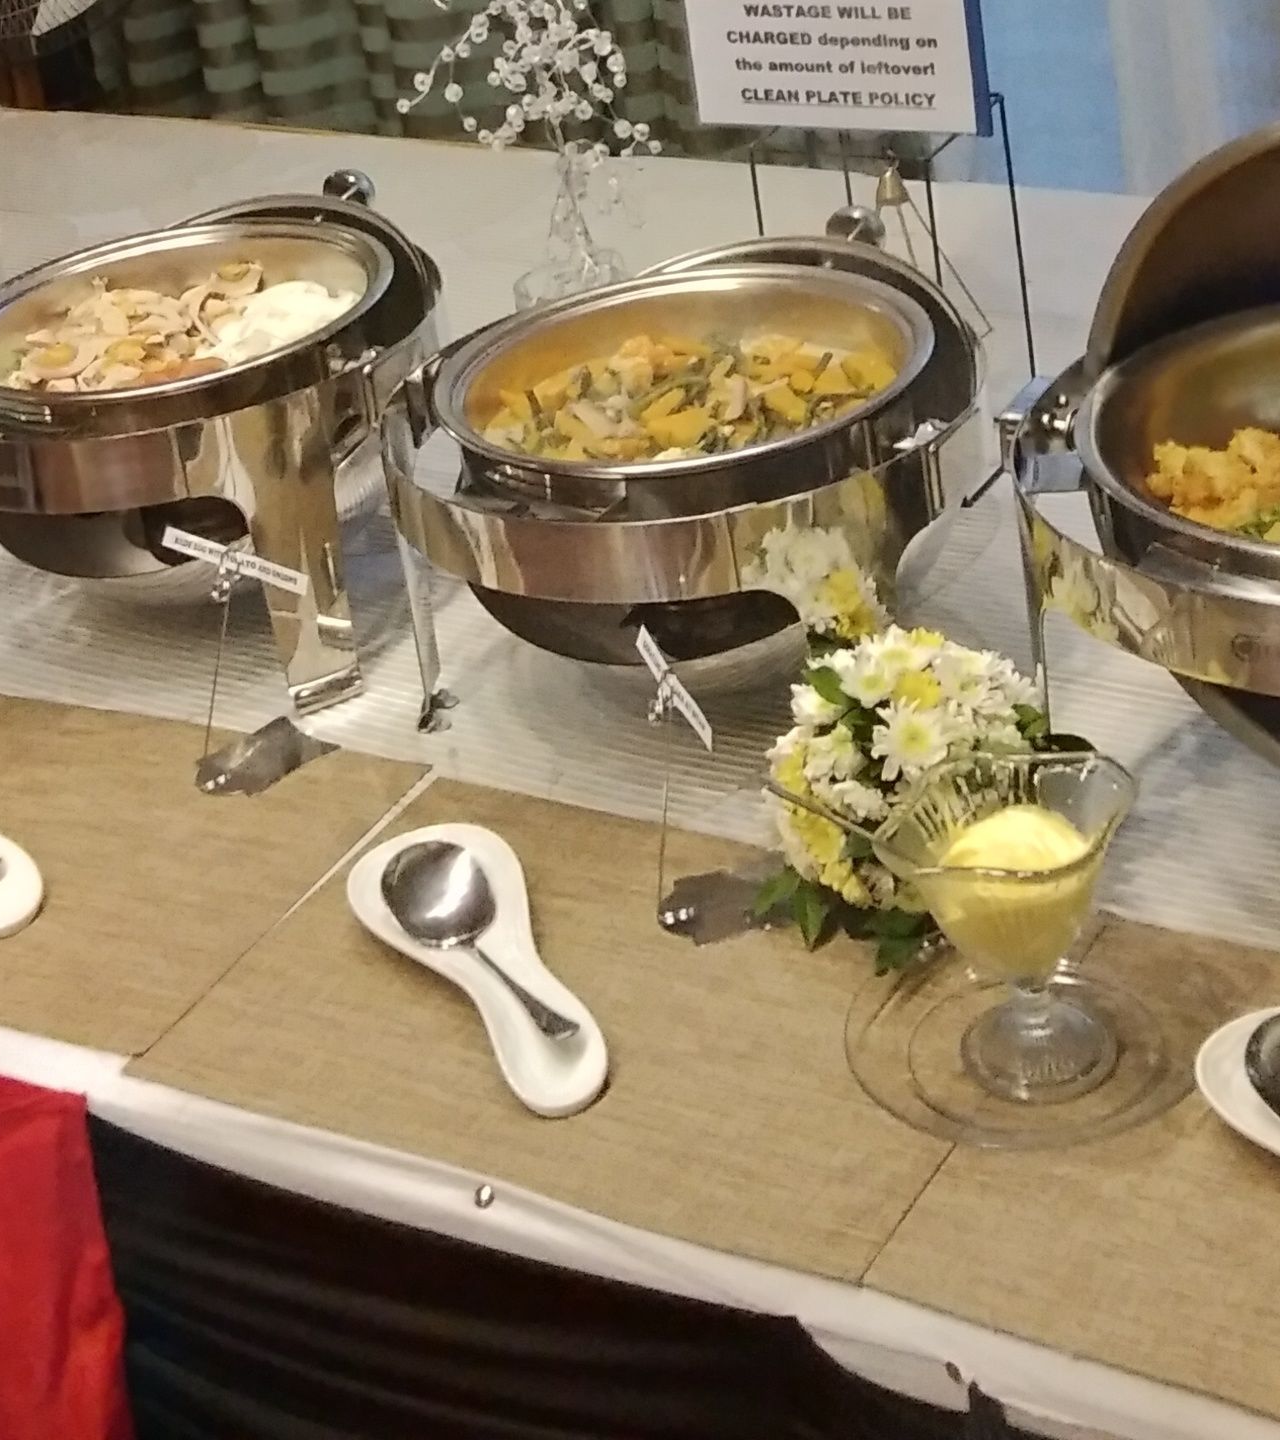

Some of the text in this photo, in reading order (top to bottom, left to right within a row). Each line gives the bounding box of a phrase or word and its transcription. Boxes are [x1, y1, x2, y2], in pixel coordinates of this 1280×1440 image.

[743, 4, 912, 20] WASTAGE WILL BE
[726, 30, 938, 51] CHARGED depending on
[735, 58, 936, 76] the amount of leftover!
[741, 88, 936, 107] CLEAN PLATE POLICY
